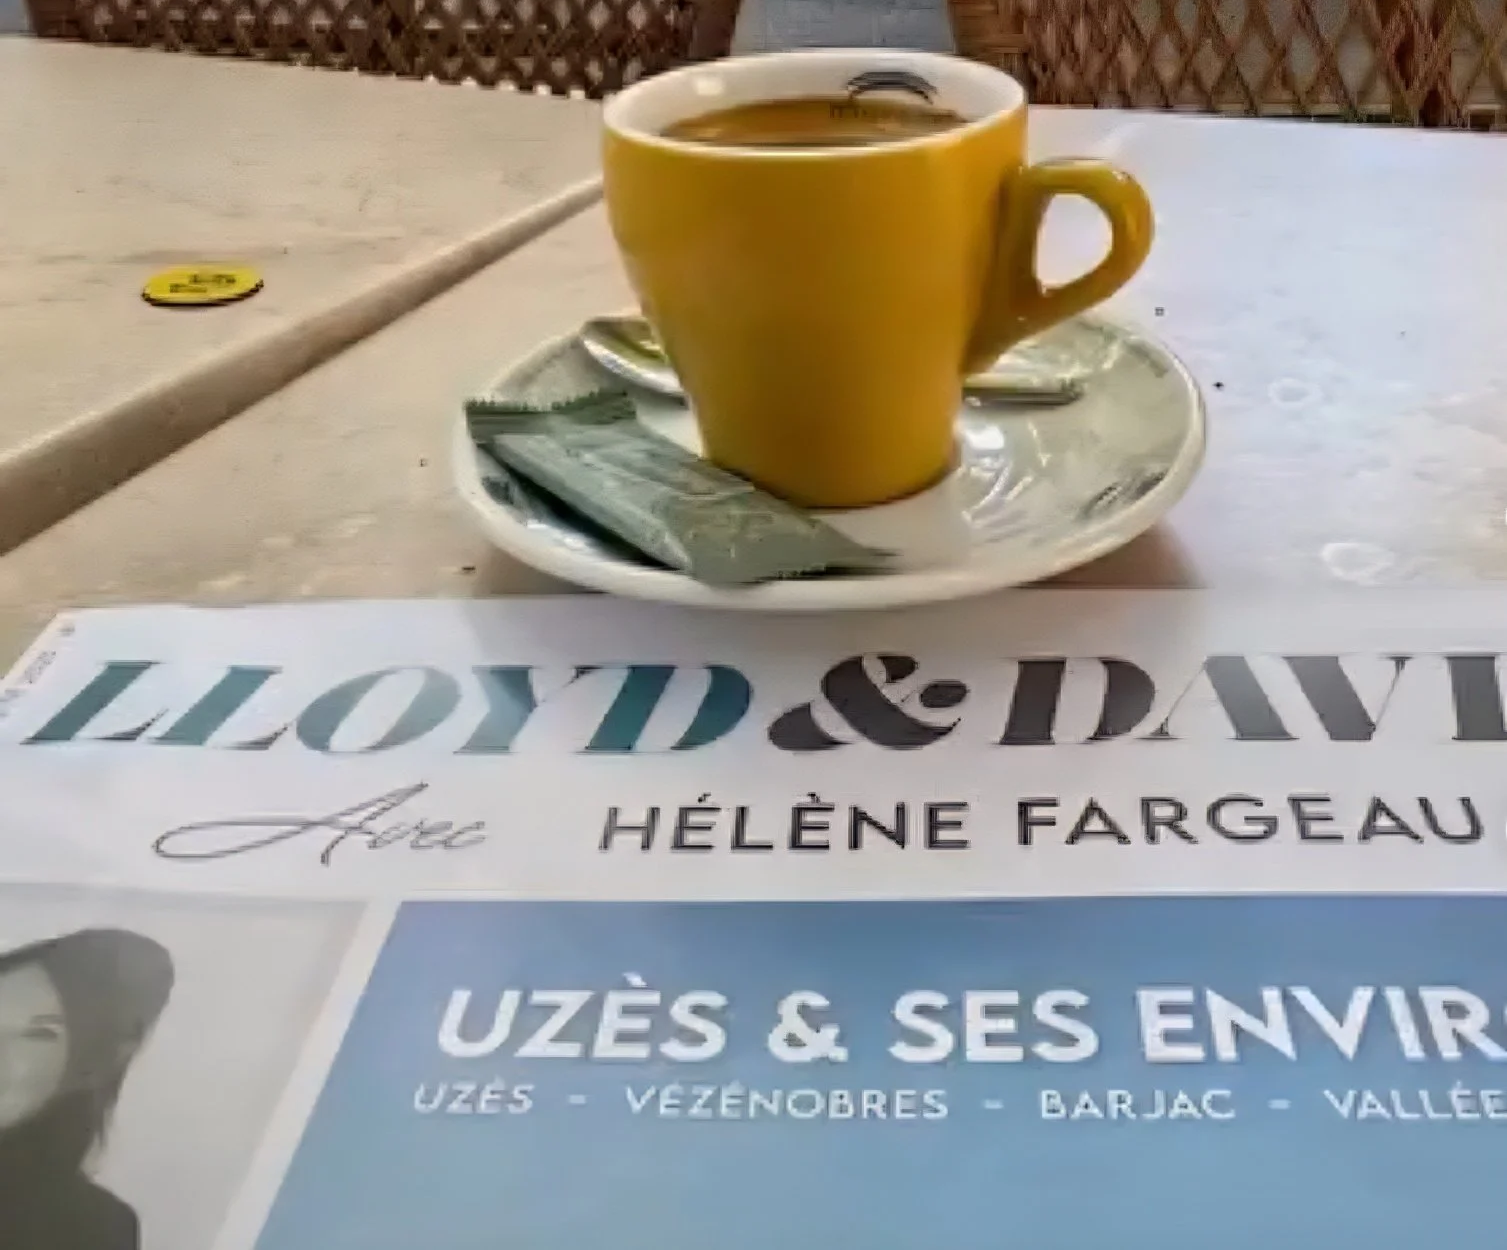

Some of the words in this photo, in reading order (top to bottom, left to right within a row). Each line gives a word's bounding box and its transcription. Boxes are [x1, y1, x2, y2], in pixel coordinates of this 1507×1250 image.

[20, 661, 755, 753] LLOYD
[768, 654, 968, 751] &
[600, 793, 969, 851] HÉLÈNE
[1017, 795, 1484, 845] FARGEAU
[437, 972, 727, 1064] UZÈS
[768, 991, 848, 1064] &
[888, 990, 1099, 1064] SES
[1136, 986, 1507, 1062] ENVIR
[1040, 1088, 1236, 1119] BARJAC
[1324, 1080, 1507, 1120] VALLÉE
